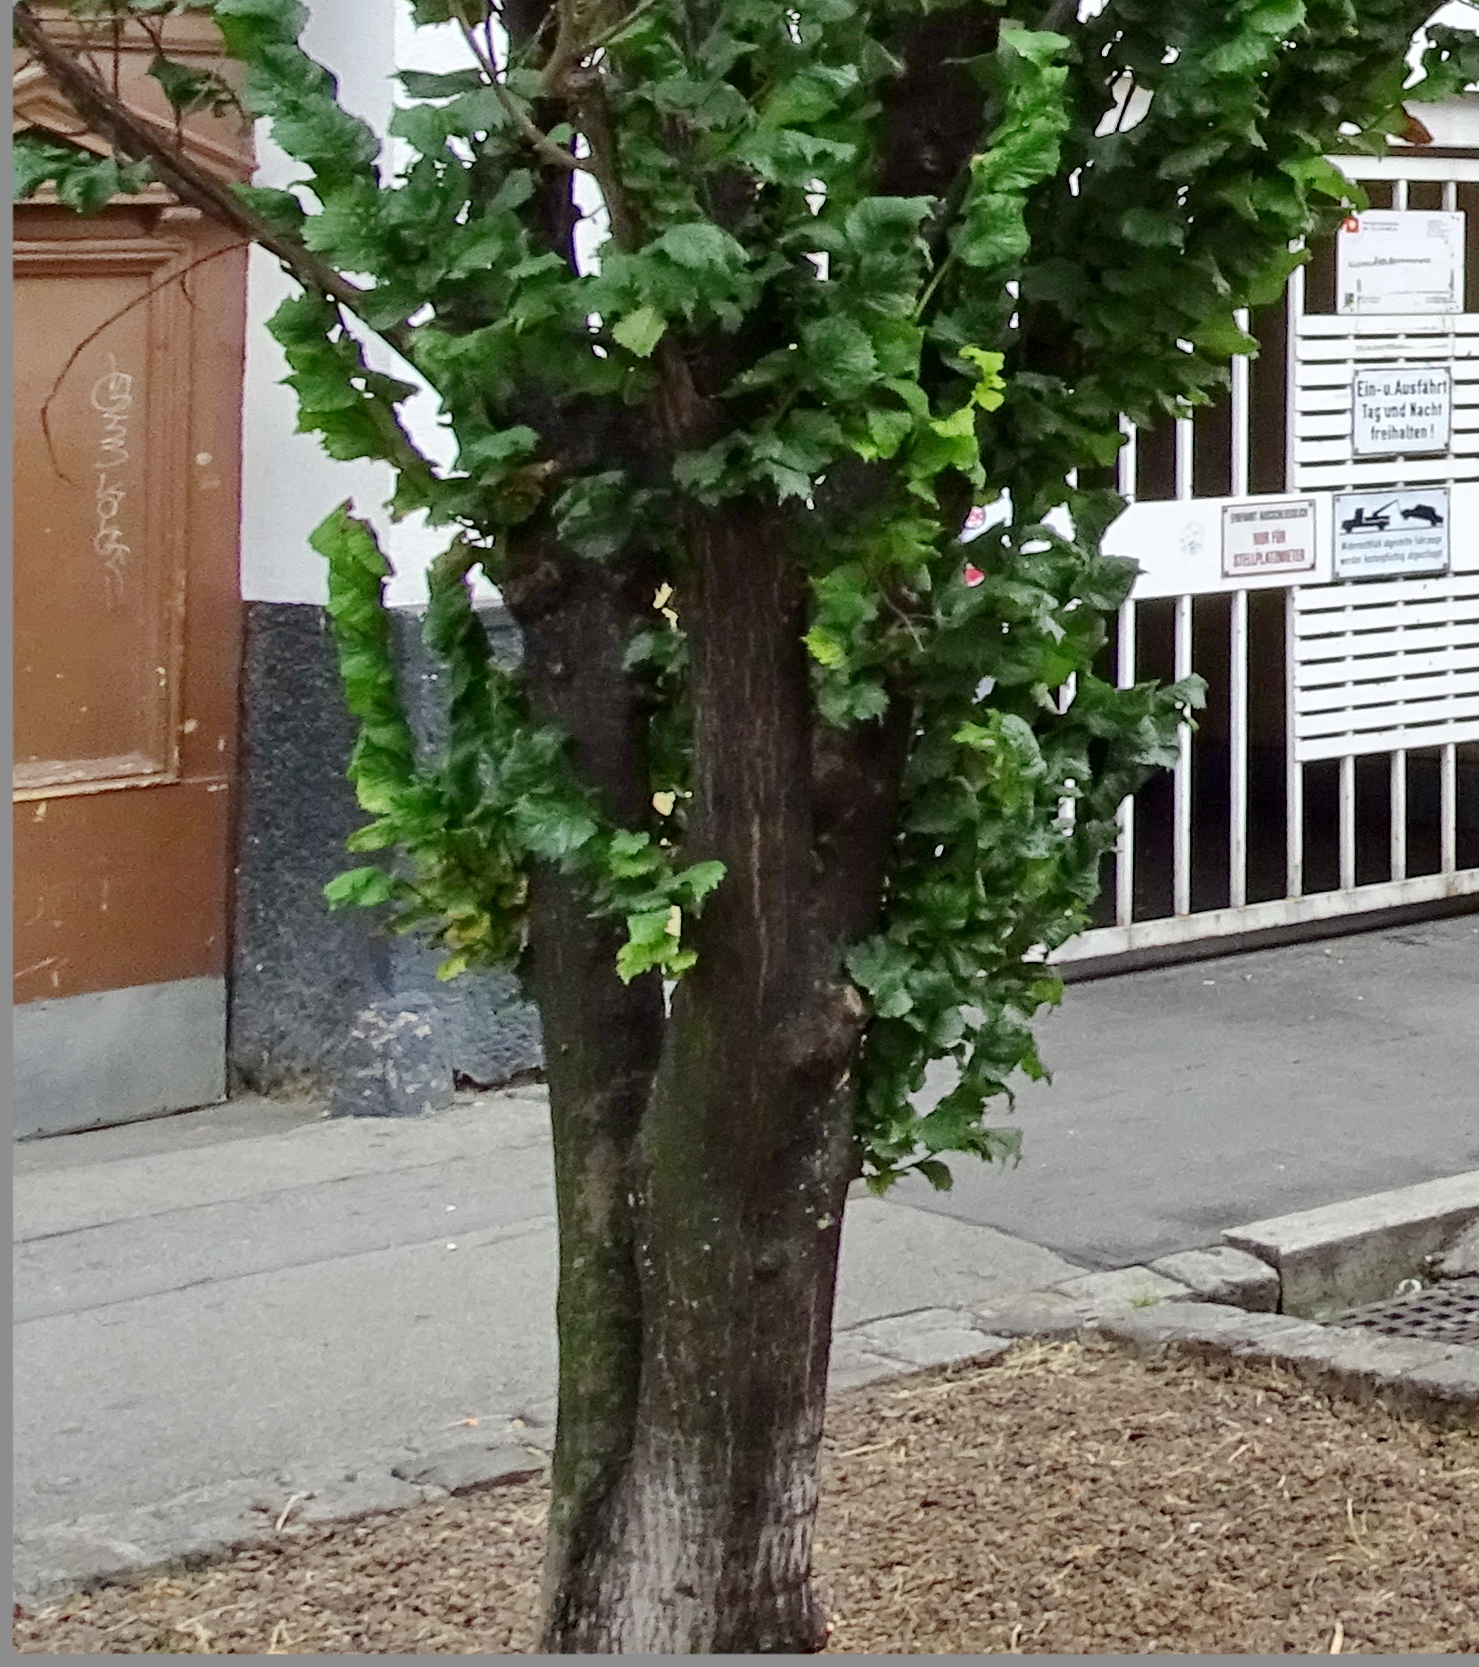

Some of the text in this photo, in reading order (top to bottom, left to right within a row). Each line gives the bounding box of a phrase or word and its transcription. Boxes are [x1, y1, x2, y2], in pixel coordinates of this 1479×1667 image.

[1362, 401, 1442, 423] Tag und Nacht
